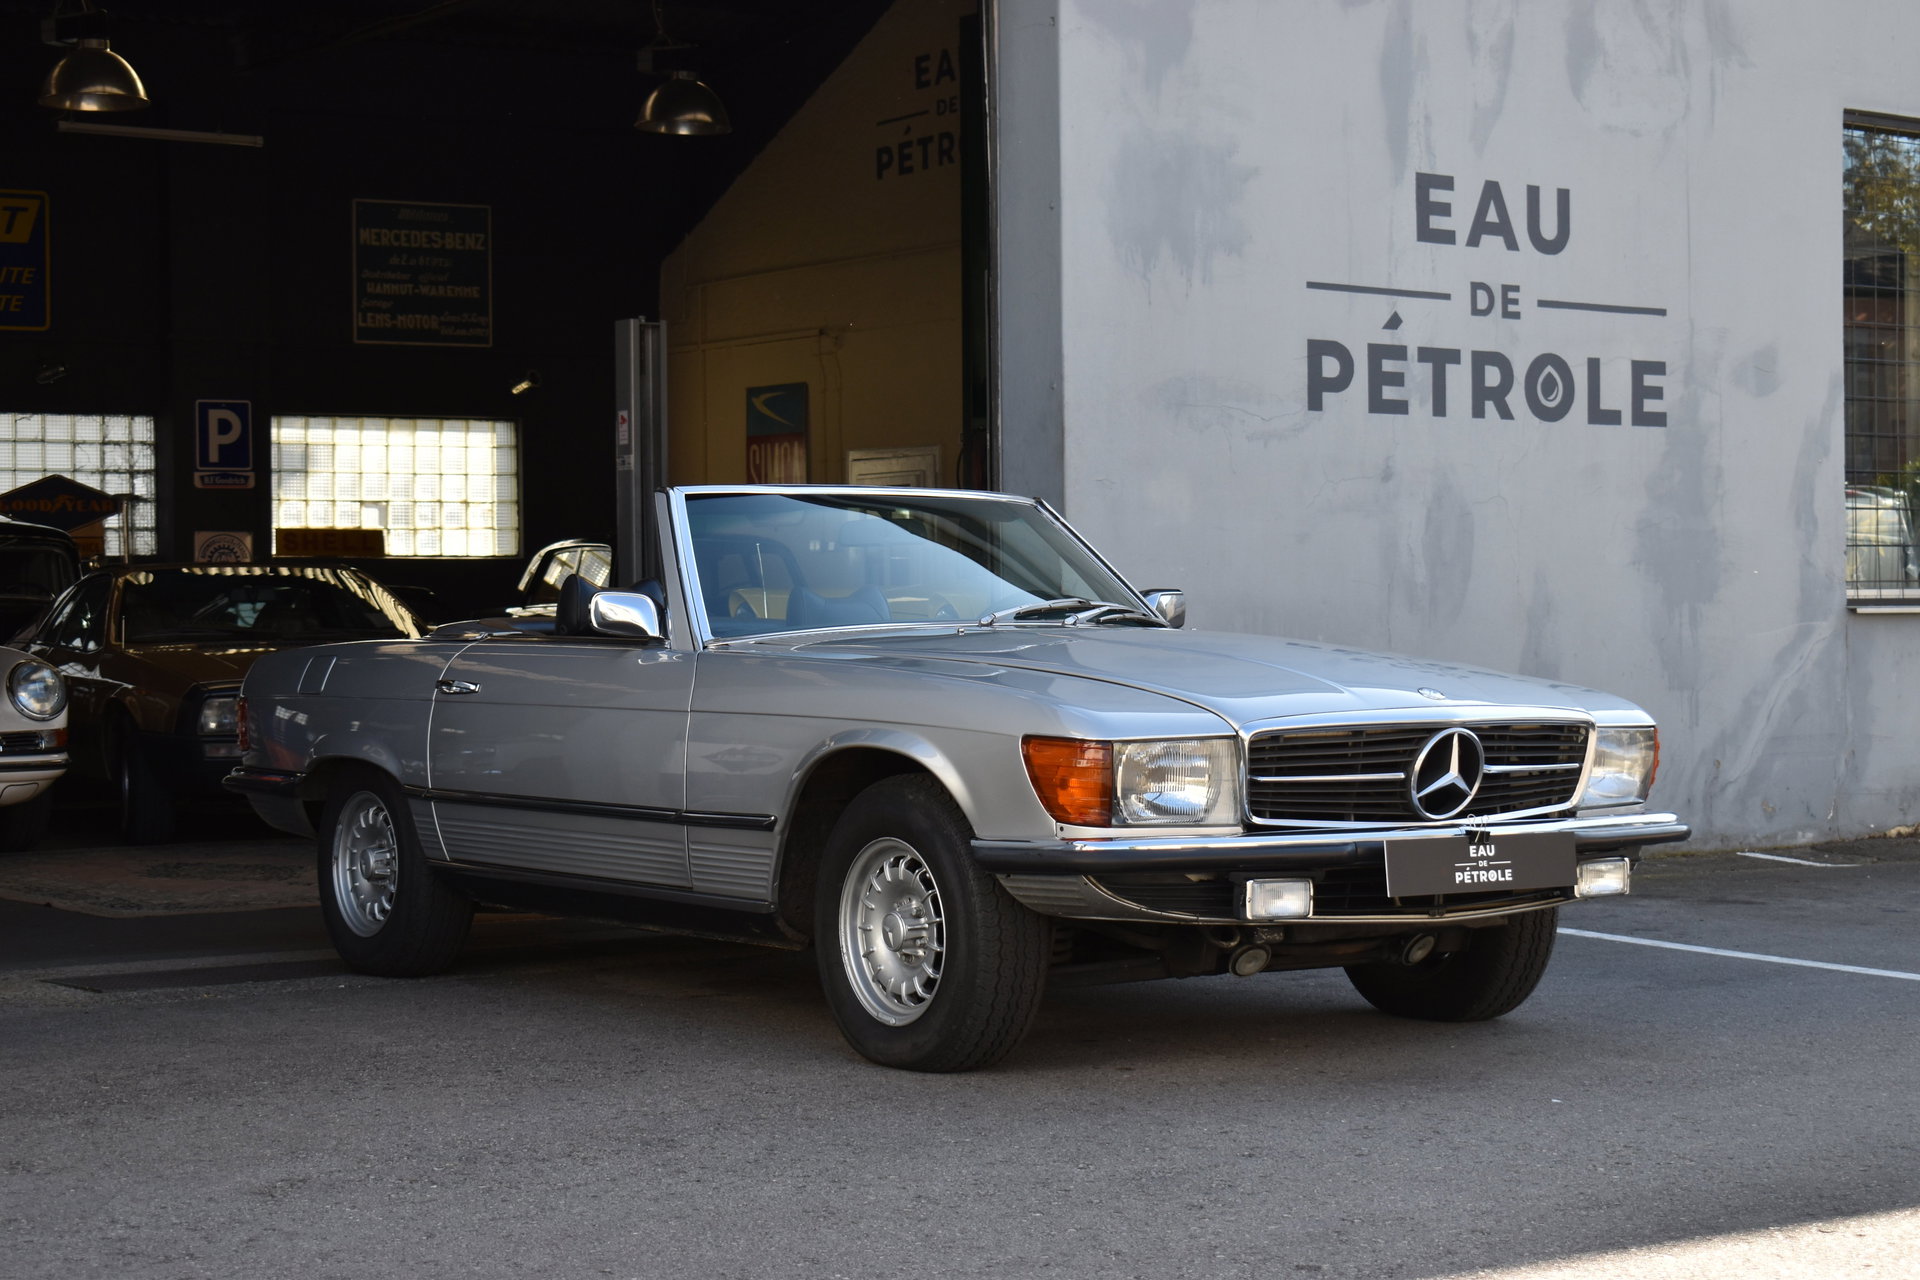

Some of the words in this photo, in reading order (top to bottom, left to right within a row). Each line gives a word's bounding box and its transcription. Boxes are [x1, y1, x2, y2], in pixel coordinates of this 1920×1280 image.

[937, 96, 957, 116] DE
[1415, 172, 1570, 255] EAU
[1470, 281, 1521, 320] DE
[1306, 310, 1667, 427] PÉTROLE
[207, 408, 242, 464] P
[283, 531, 377, 552] SHELL
[1469, 844, 1495, 858] EAU
[1455, 867, 1513, 884] PÉTROLE
